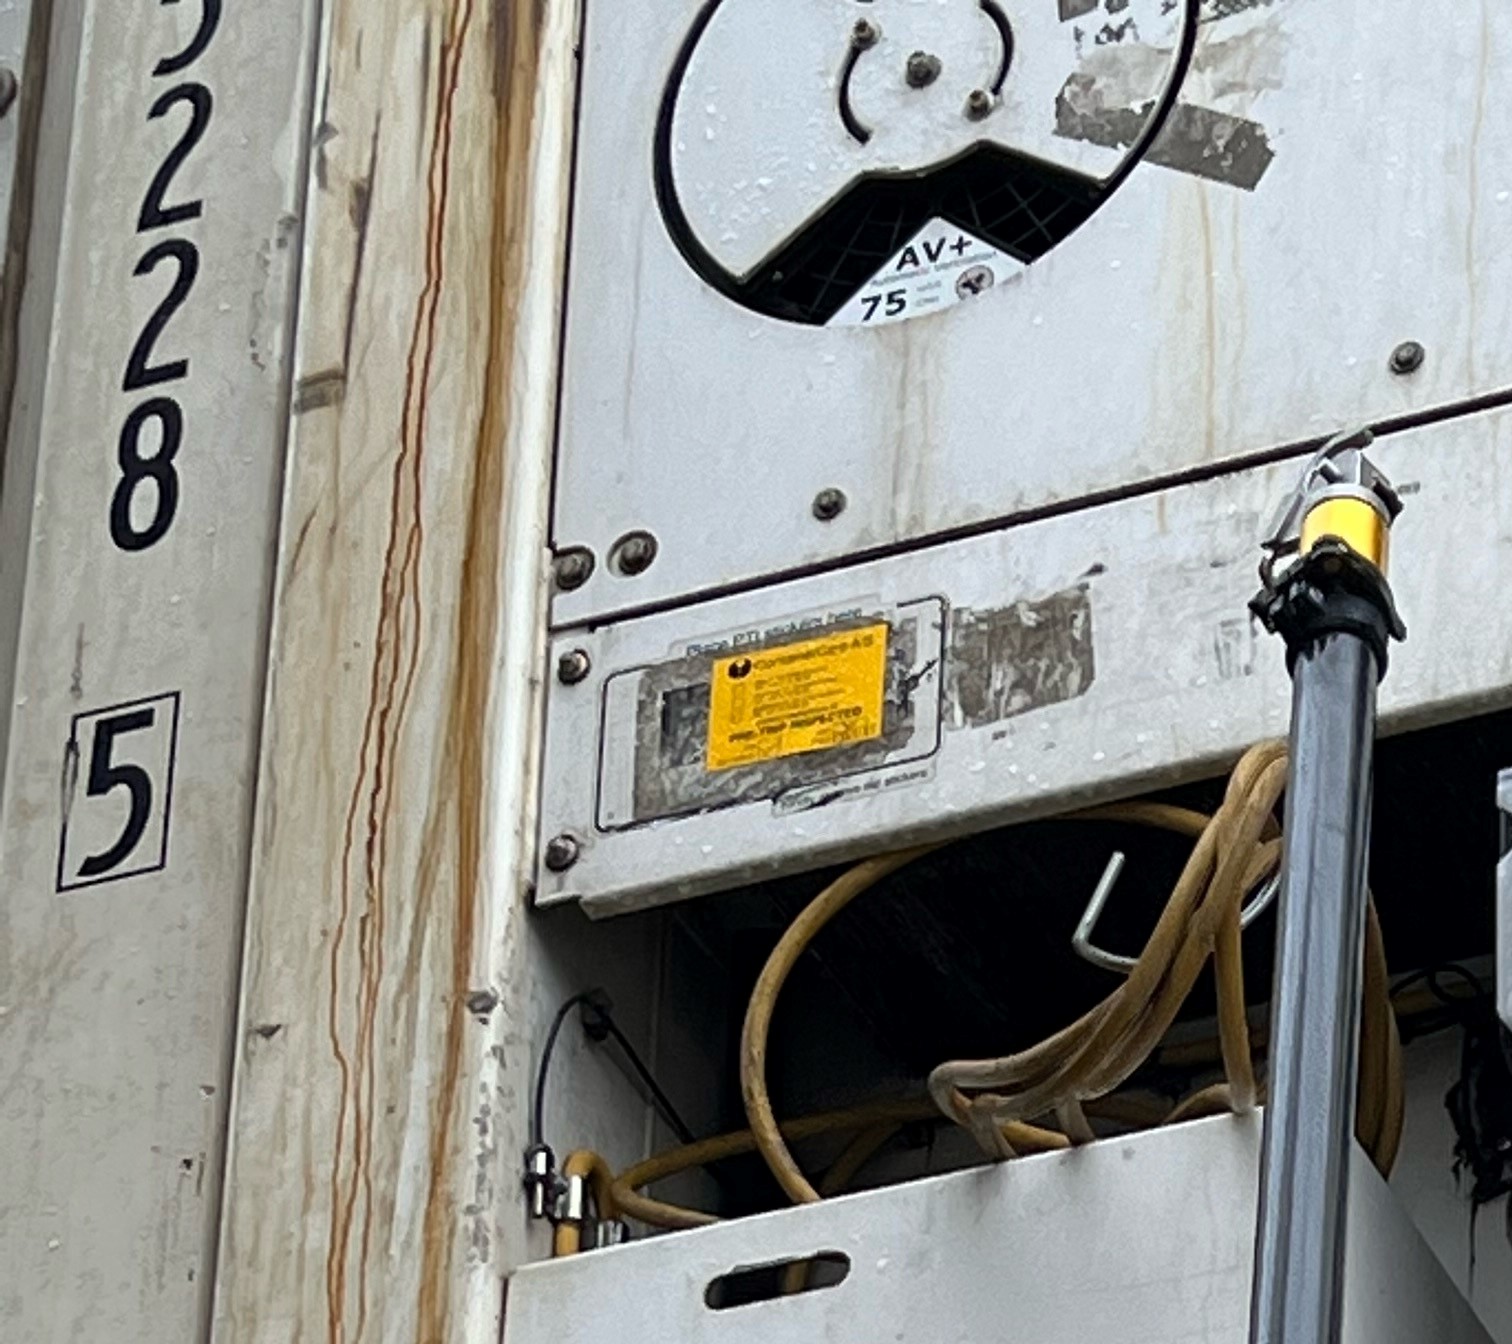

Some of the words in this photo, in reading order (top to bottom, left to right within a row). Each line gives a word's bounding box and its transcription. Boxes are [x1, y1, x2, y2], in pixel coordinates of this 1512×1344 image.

[896, 236, 972, 271] AV+
[861, 289, 907, 321] 75
[76, 708, 155, 877] 5
